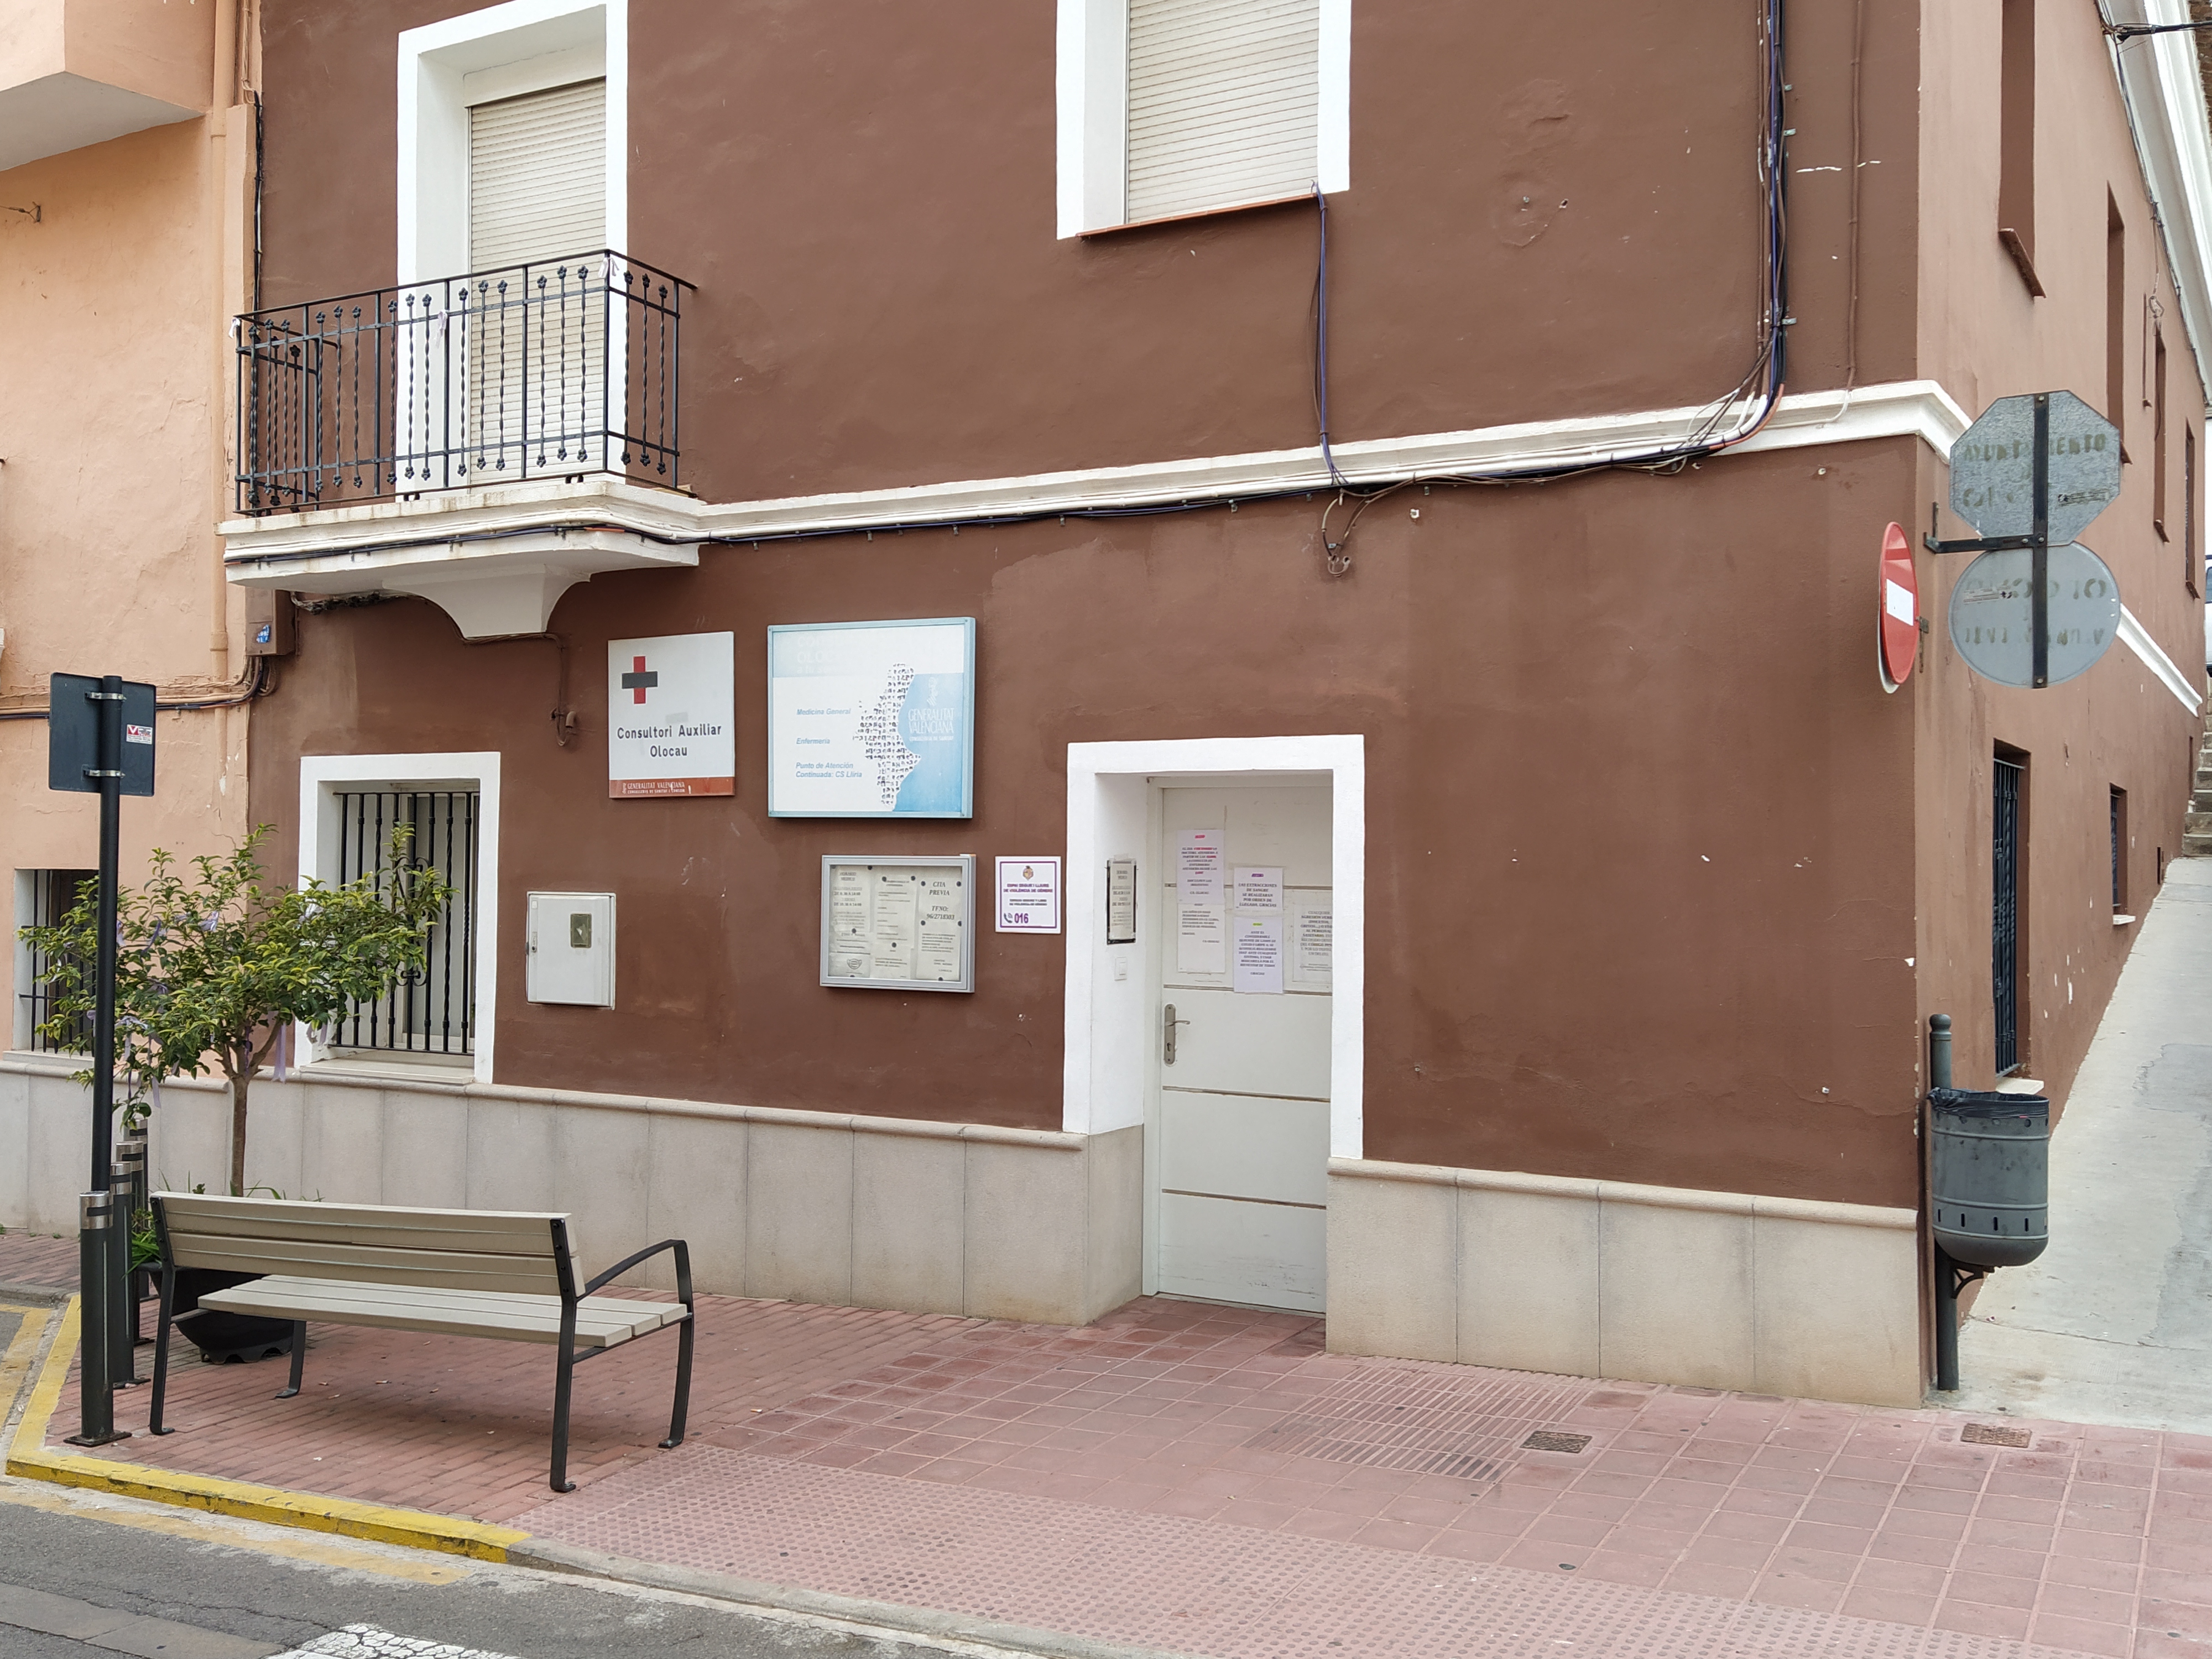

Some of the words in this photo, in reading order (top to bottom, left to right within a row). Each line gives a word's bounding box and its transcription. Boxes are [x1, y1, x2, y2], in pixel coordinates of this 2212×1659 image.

[908, 708, 954, 721] GENERALITAT
[617, 726, 672, 739] Consultori
[678, 724, 721, 737] Auxiliar
[909, 720, 954, 734] VALENCIANA
[650, 745, 687, 757] Olocau
[1014, 913, 1029, 923] 016
